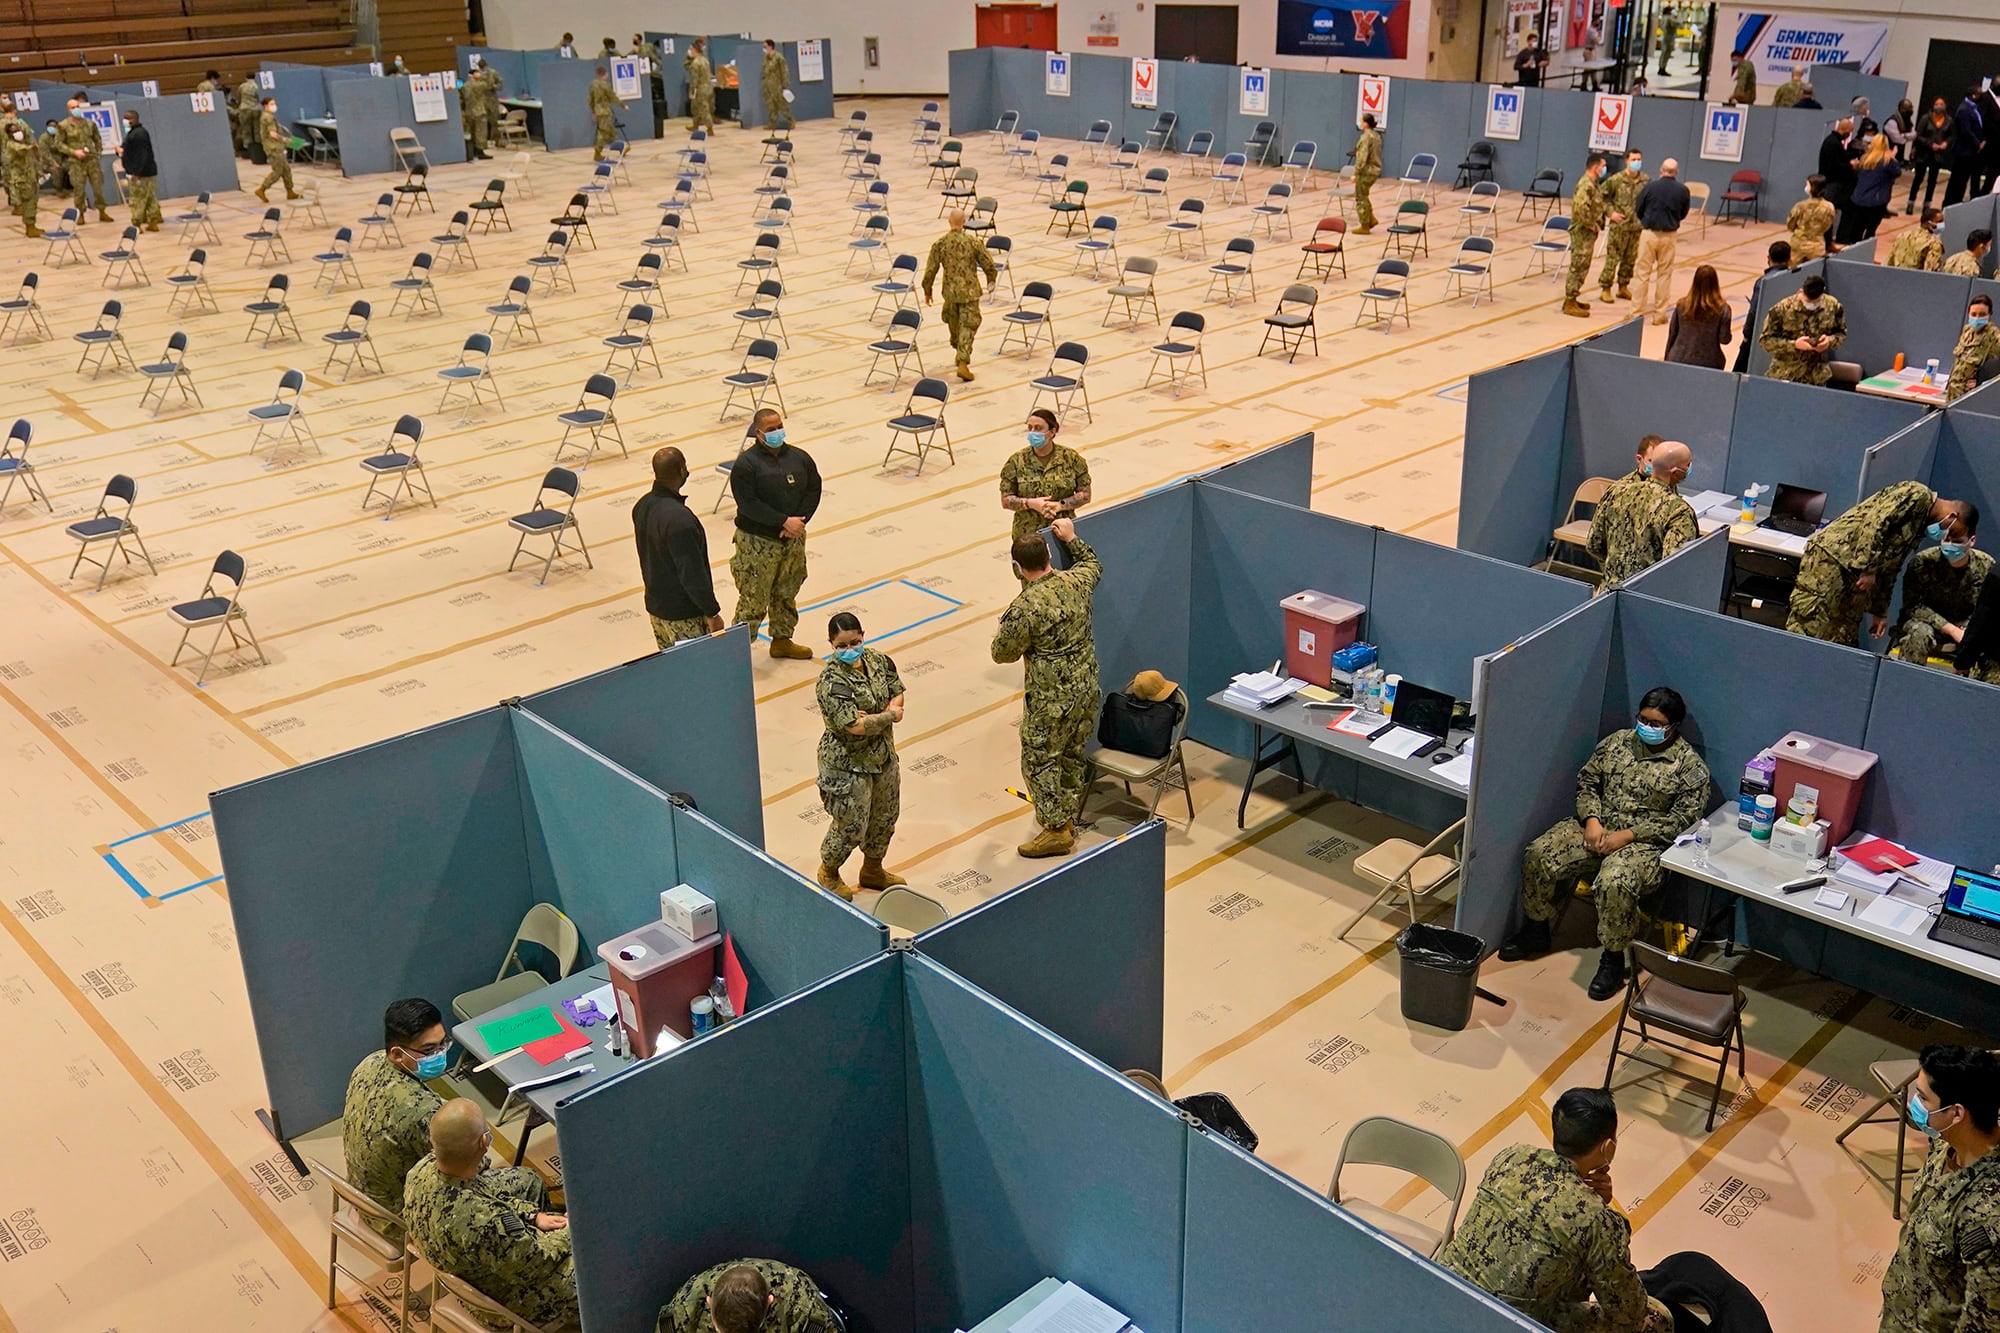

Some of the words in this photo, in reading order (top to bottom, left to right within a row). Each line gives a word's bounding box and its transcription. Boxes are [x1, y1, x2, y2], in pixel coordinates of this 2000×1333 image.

[1776, 28, 1845, 47] GAMEDAY
[145, 84, 153, 96] 9
[18, 95, 33, 108] 11
[195, 97, 209, 109] 10
[1209, 903, 1225, 915] RAM
[1224, 892, 1246, 907] BOARD
[1308, 1051, 1328, 1065] RAM
[1323, 1036, 1349, 1054] BOARD
[163, 1058, 184, 1079] BOARD
[179, 1075, 197, 1090] RAM
[1804, 1094, 1823, 1112] RAM
[1819, 1077, 1841, 1098] BOARD
[254, 1161, 278, 1186] BOARD
[273, 1184, 293, 1202] RAM
[1703, 1194, 1724, 1216] RAM
[1719, 1177, 1745, 1201] BOARD
[4, 1241, 23, 1260] RAM
